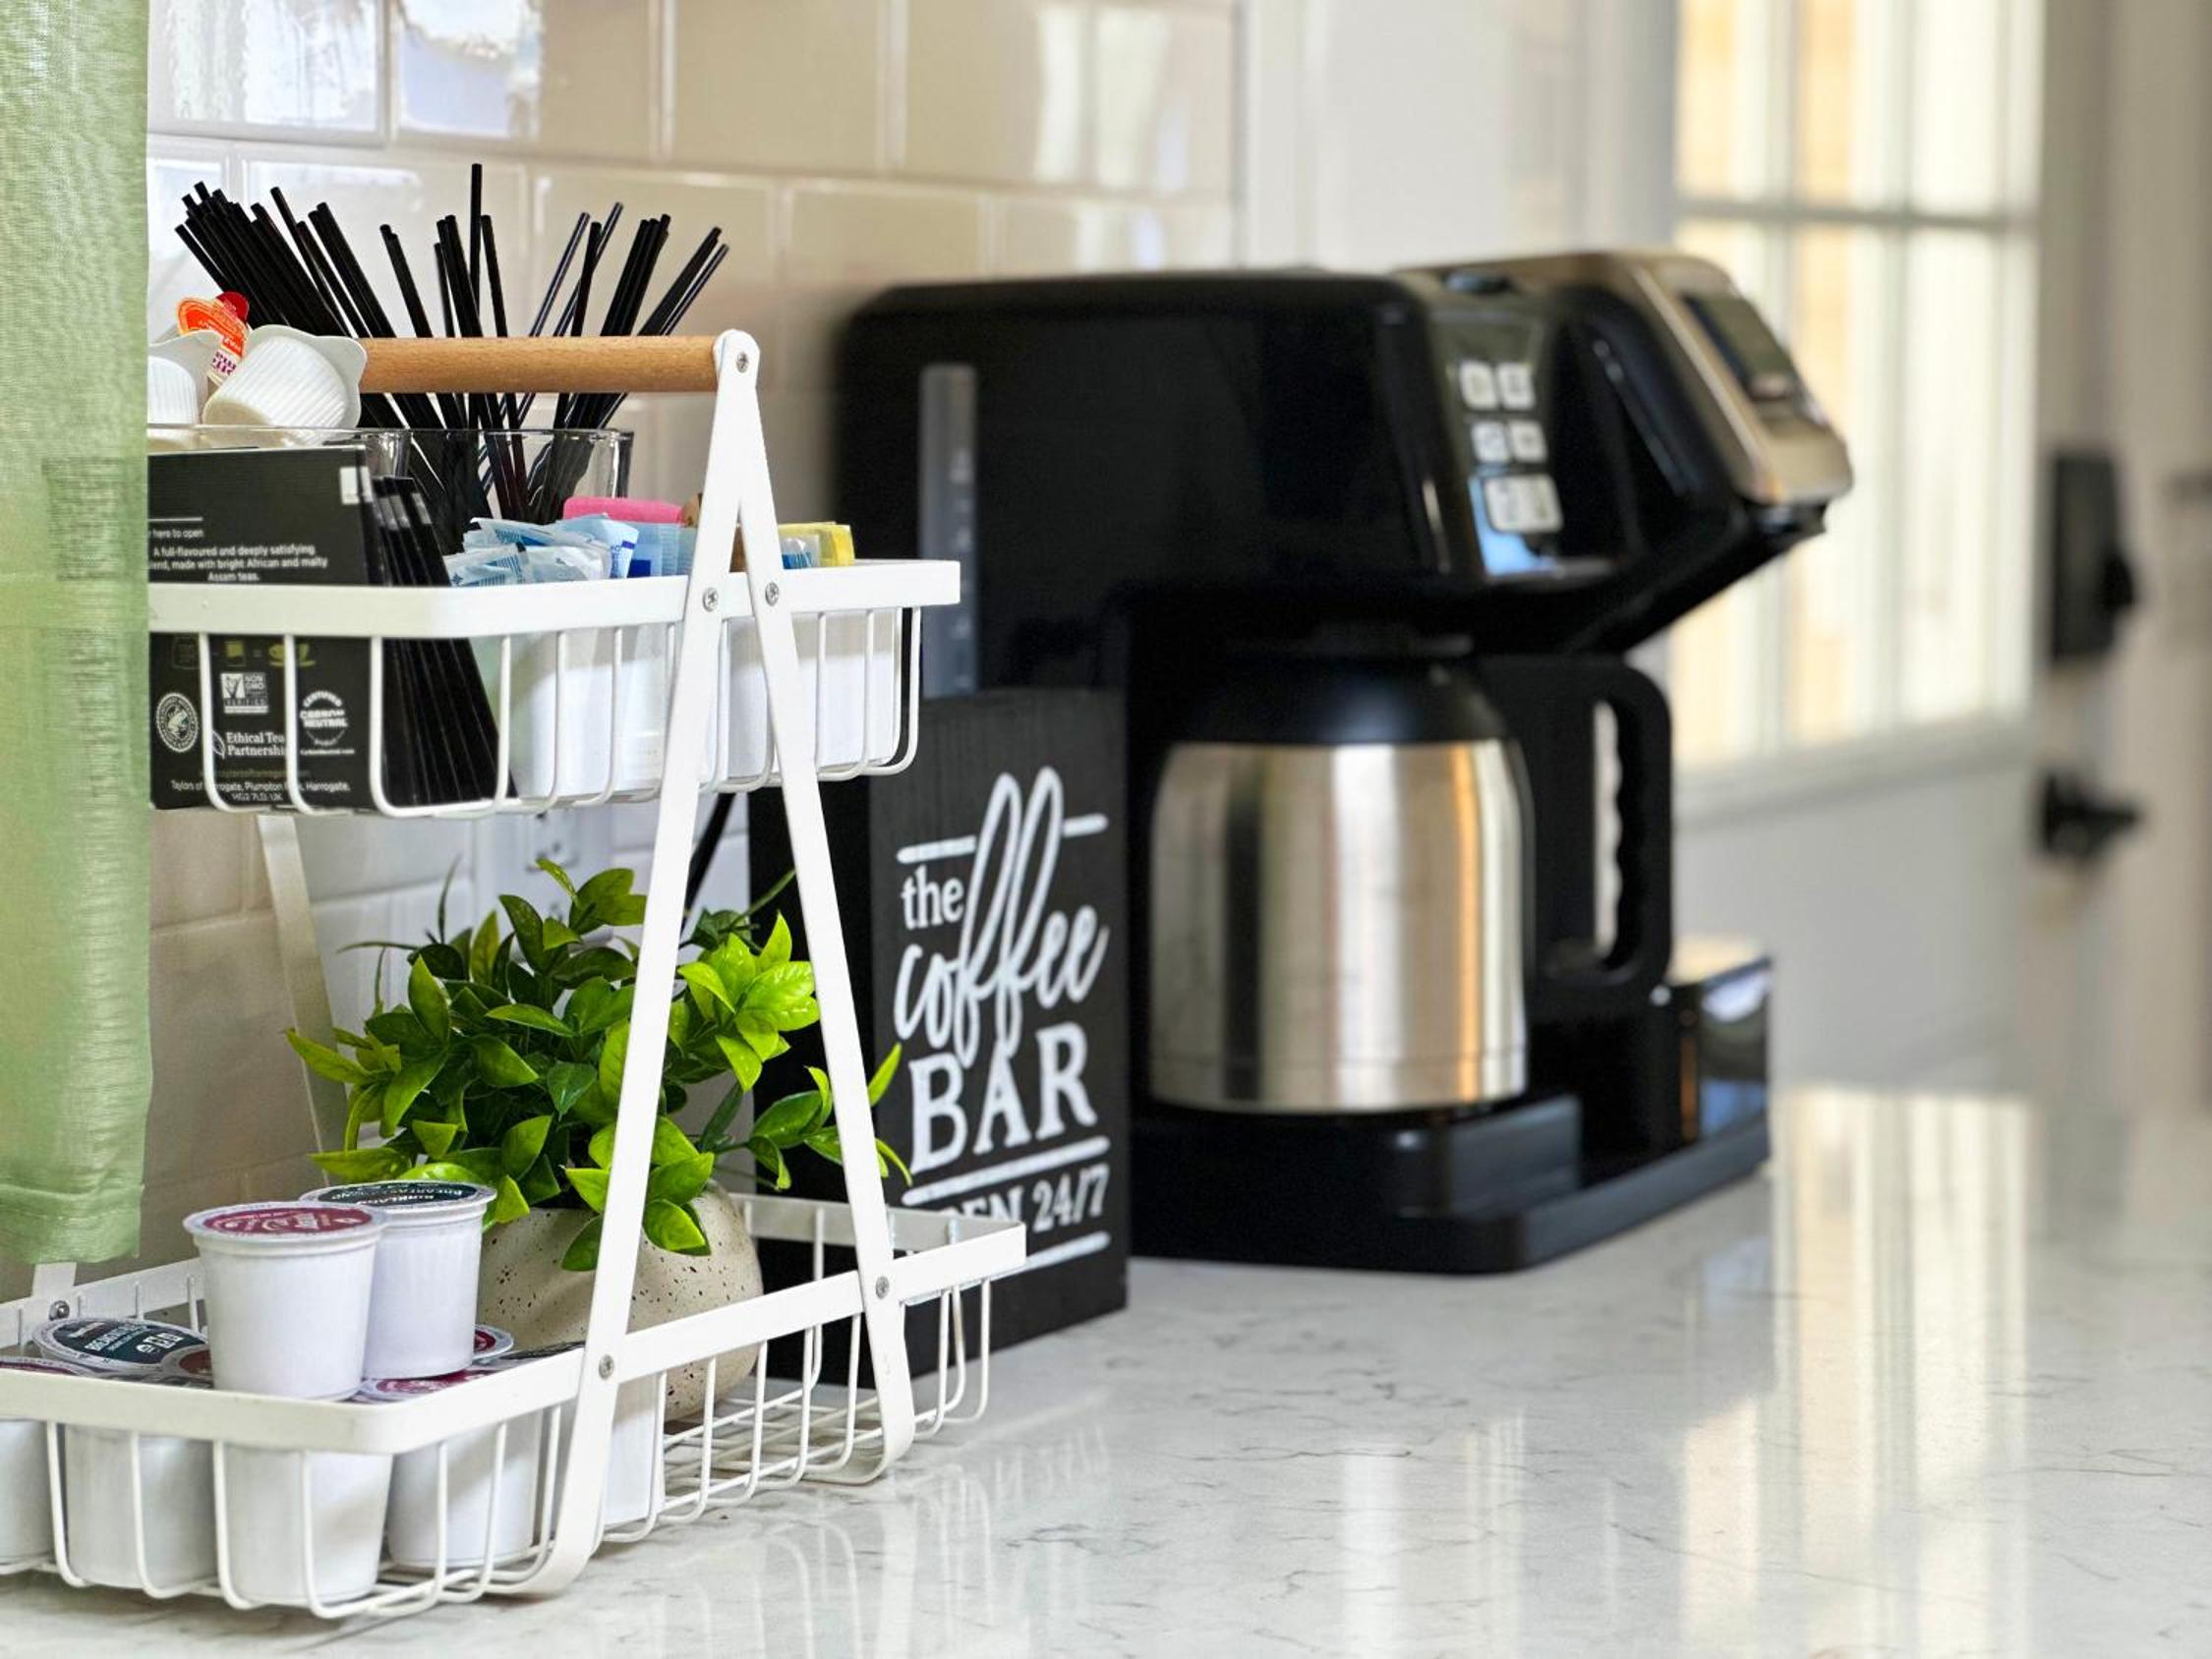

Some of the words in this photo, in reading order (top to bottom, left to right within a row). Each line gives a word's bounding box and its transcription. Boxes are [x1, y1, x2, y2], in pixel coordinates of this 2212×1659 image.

[161, 545, 217, 557] full-flavoured
[219, 545, 236, 555] and
[238, 544, 268, 556] deeply
[270, 543, 316, 555] satisfying
[172, 559, 196, 569] made
[198, 558, 216, 568] with
[217, 557, 245, 570] bright
[247, 557, 280, 568] African
[282, 556, 300, 567] and
[225, 732, 264, 744] Ethical
[226, 744, 286, 757] Partnershi
[901, 864, 965, 930] the
[894, 766, 1110, 1069] coffee
[907, 1020, 1097, 1175] BAR
[1032, 1162, 1111, 1233] 24/7
